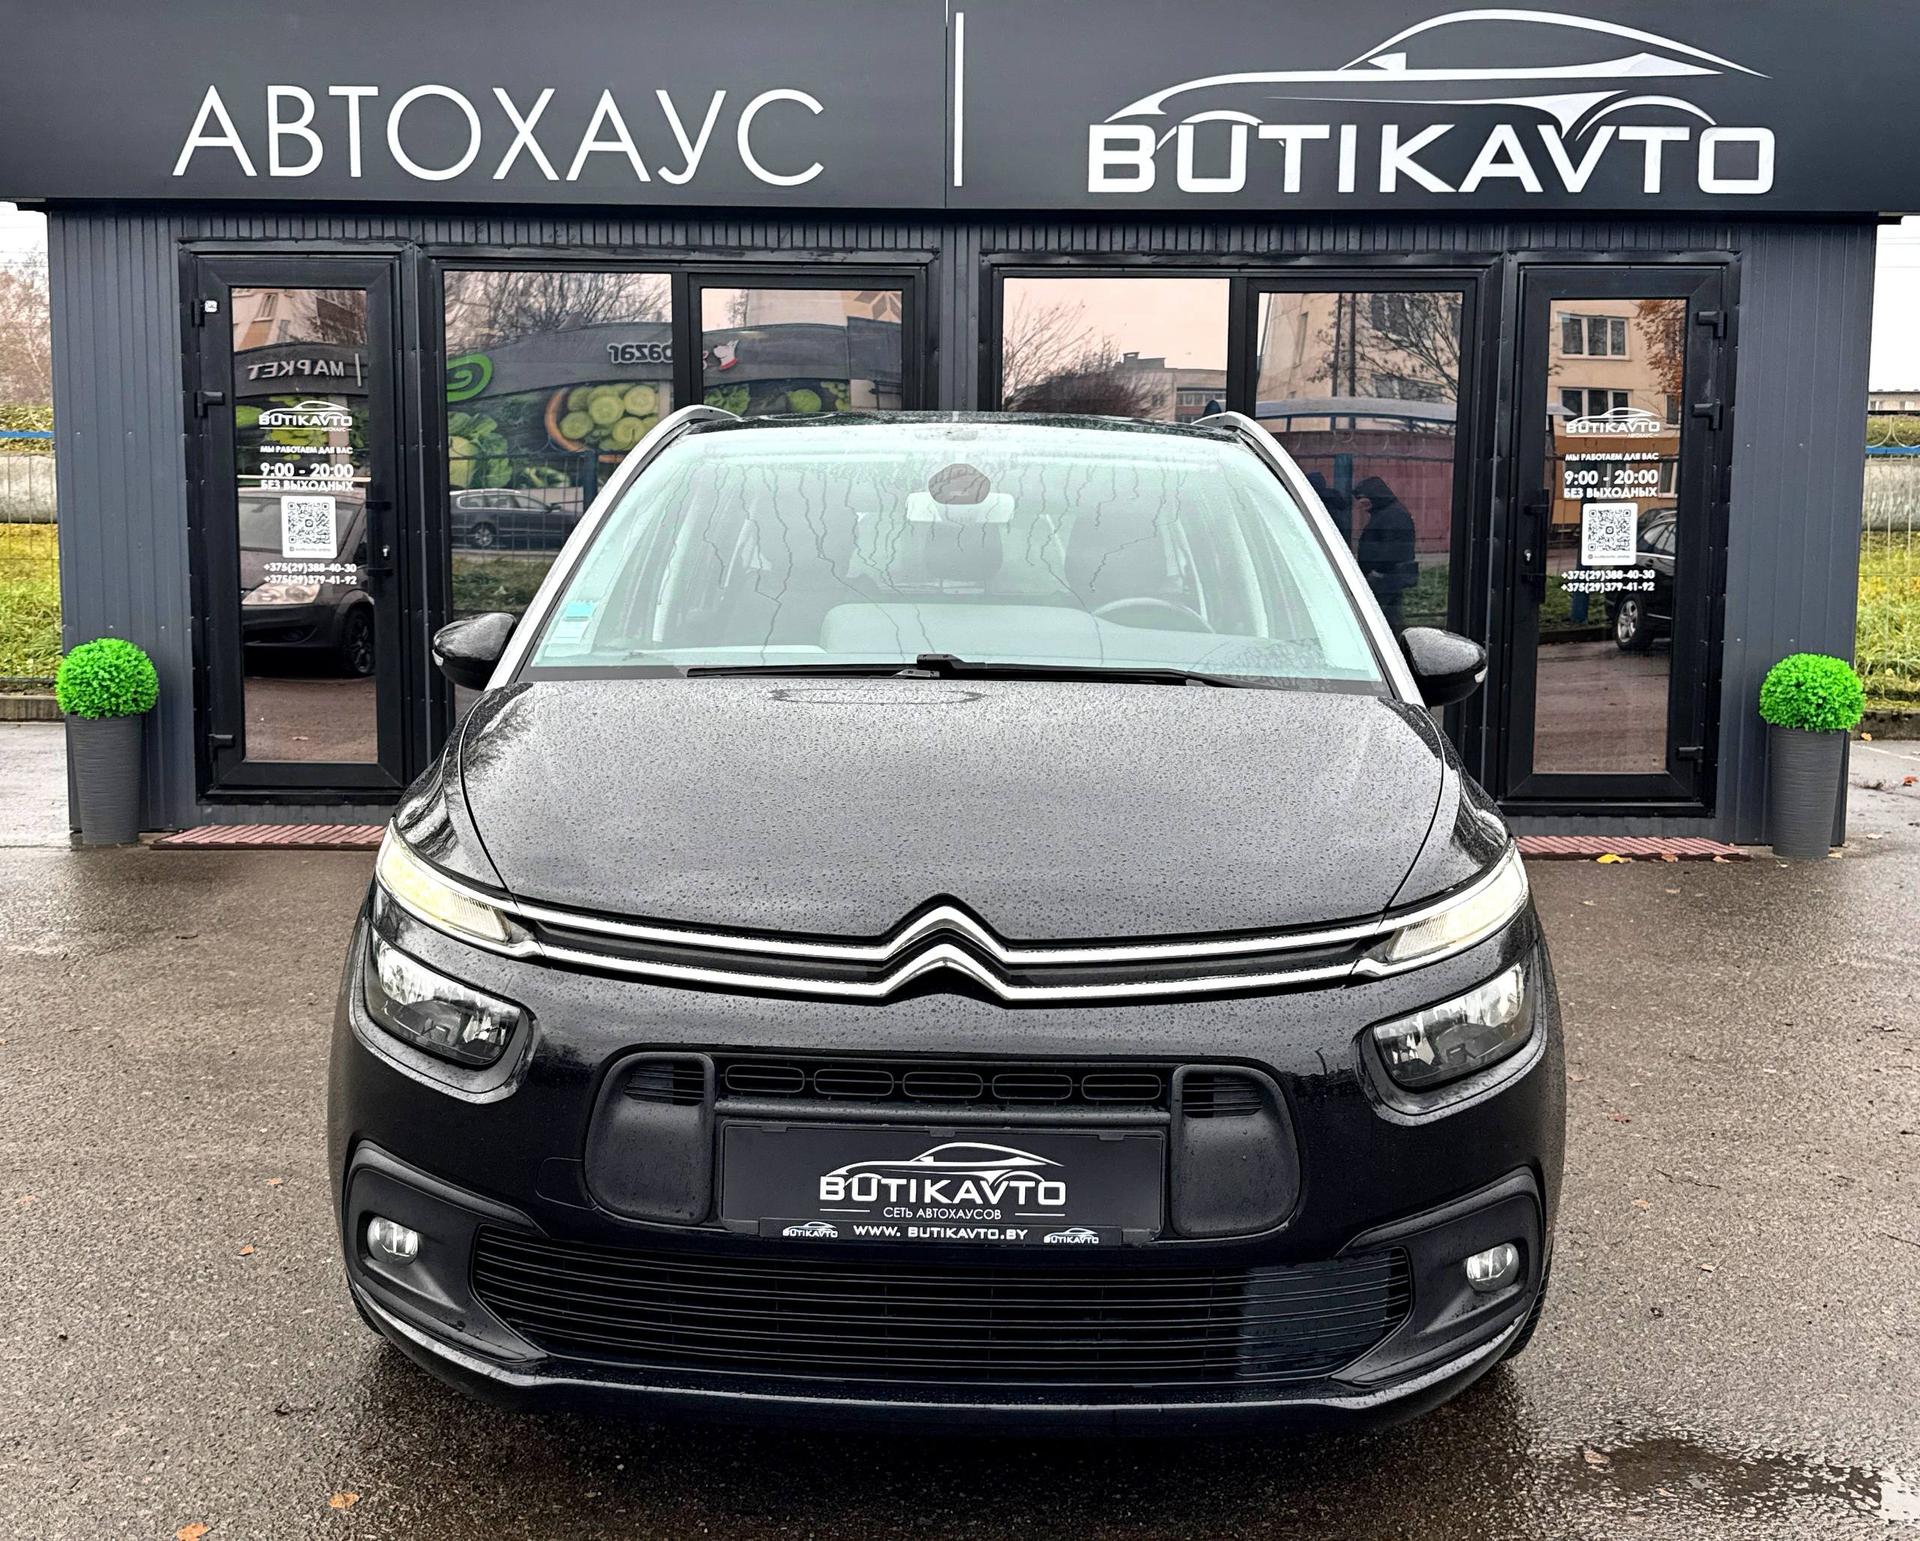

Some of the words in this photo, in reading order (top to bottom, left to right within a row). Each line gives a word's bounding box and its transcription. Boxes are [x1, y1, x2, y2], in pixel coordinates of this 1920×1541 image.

[172, 83, 825, 187] АВТОХАУС
[1087, 123, 1776, 195] BUTIKAVTO
[259, 413, 353, 427] BUTIKAVTO
[1566, 421, 1661, 434] BUTIKAVTO
[260, 462, 294, 477] 9:00
[309, 463, 354, 478] 20:00
[1564, 470, 1599, 485] 9:00
[1613, 470, 1658, 485] 20:00
[261, 480, 281, 490] БЕЗ
[283, 480, 354, 491] ВЫХОДНЫХ
[1564, 487, 1584, 498] БЕЗ
[1586, 487, 1658, 499] ВЫХОДНЫХ
[819, 1175, 1067, 1206] BUTIKAVTO
[883, 1207, 913, 1219] СЕТЬ
[915, 1207, 1002, 1221] АВТОХАУСОВ
[907, 1226, 1029, 1240] BUTIKAVTO.BY
